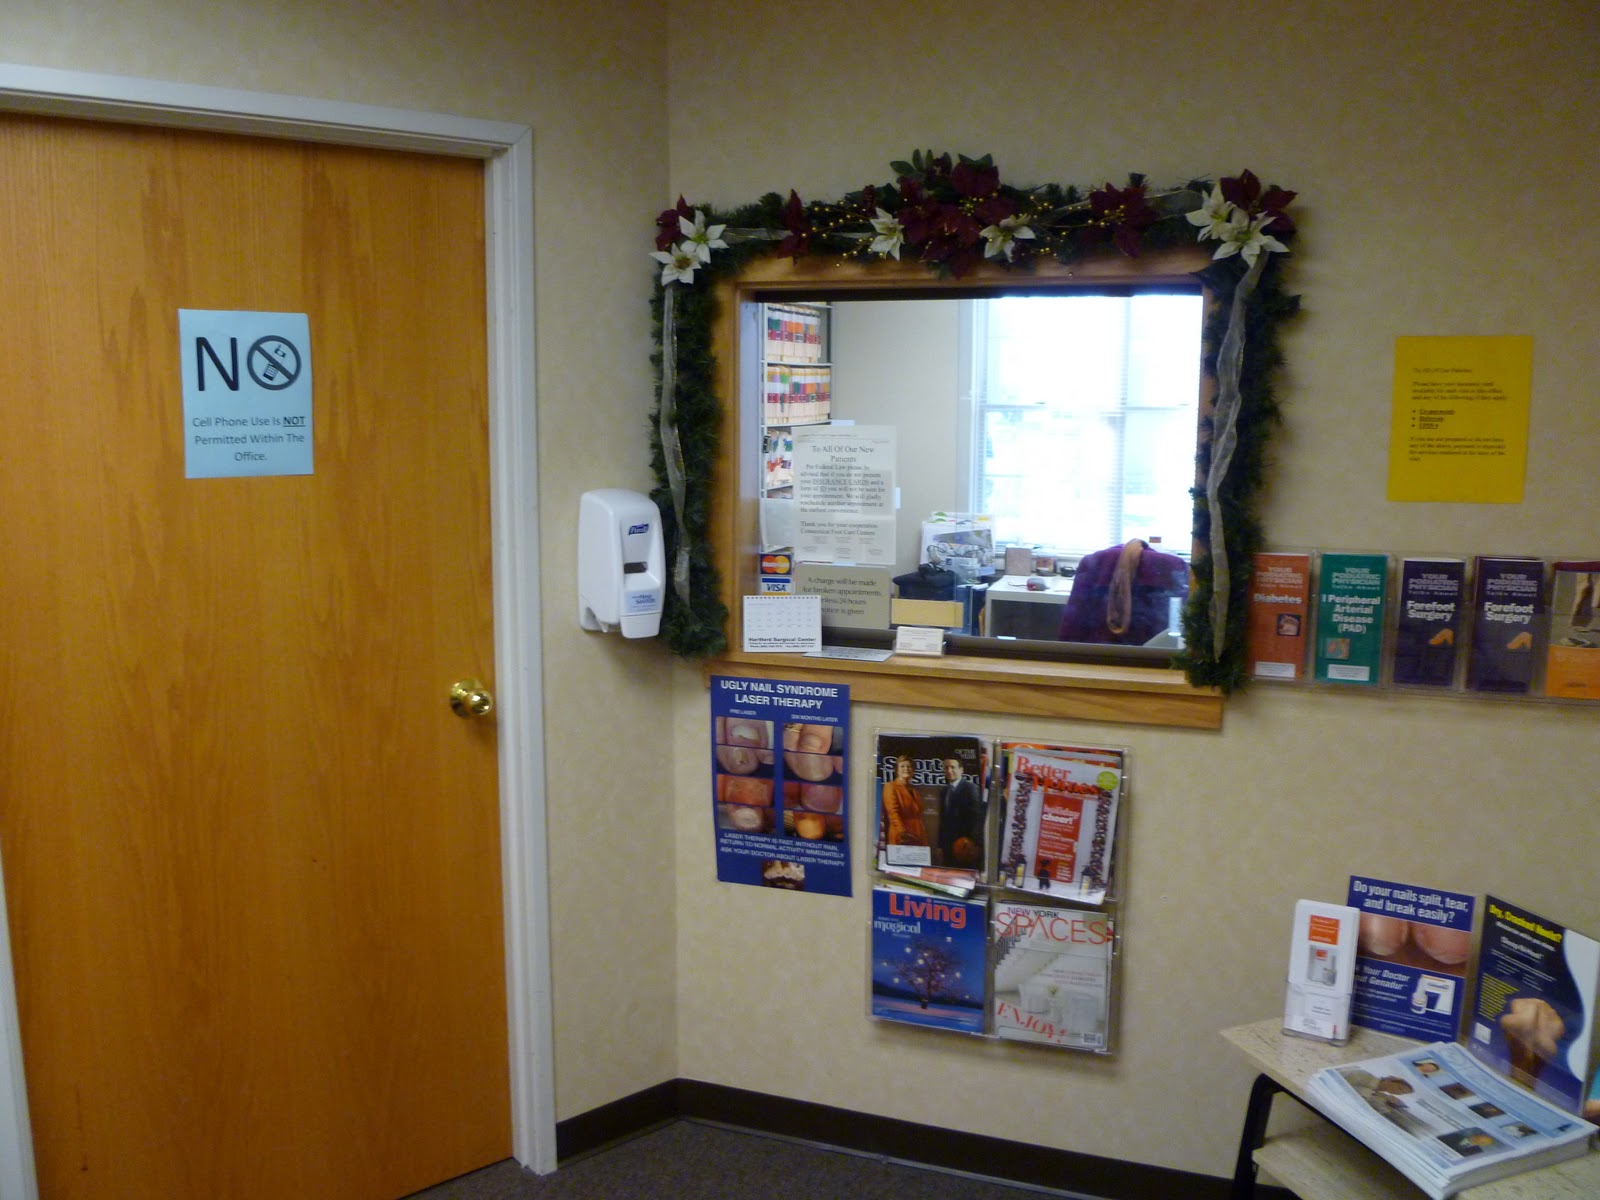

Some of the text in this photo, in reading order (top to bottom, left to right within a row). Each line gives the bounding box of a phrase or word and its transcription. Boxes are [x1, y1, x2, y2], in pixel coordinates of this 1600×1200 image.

[193, 416, 306, 427] Cell Phone Use Is NOT
[194, 433, 305, 445] Permitted Within The
[234, 452, 267, 461] Office.
[831, 455, 856, 463] Patients
[814, 578, 835, 587] charge
[859, 578, 877, 586] made
[1254, 593, 1302, 604] Diabetes
[1328, 594, 1381, 606] Peripheral
[847, 608, 865, 617] given
[1333, 604, 1374, 614] Arterial
[1406, 600, 1456, 612] Forefoot
[1484, 601, 1535, 614] Forefoot
[1332, 614, 1374, 624] Disease
[1407, 608, 1453, 622] Surgery
[1485, 610, 1532, 625] Surgery
[1338, 624, 1367, 634] (PAD)
[720, 680, 838, 698] UGLY NAIL SYNDROME
[735, 694, 823, 709] LASER THERAPY
[883, 756, 944, 772] Sort
[1016, 755, 1072, 779] Better
[1031, 775, 1099, 795] Homes
[720, 838, 744, 846] RETURN
[724, 832, 743, 840] LASER
[744, 834, 771, 843] THERAPY
[751, 850, 776, 858] DOCTOR
[817, 859, 845, 867] THERAPY
[1353, 880, 1469, 912] Do your nails split, tear,
[889, 893, 966, 929] Living
[1007, 906, 1060, 919] NEW YORK
[1363, 899, 1456, 924] and break easily?
[874, 920, 921, 934] magical
[995, 912, 1106, 945] SPACES
[1363, 966, 1381, 976] Your
[1382, 969, 1410, 982] Doctor
